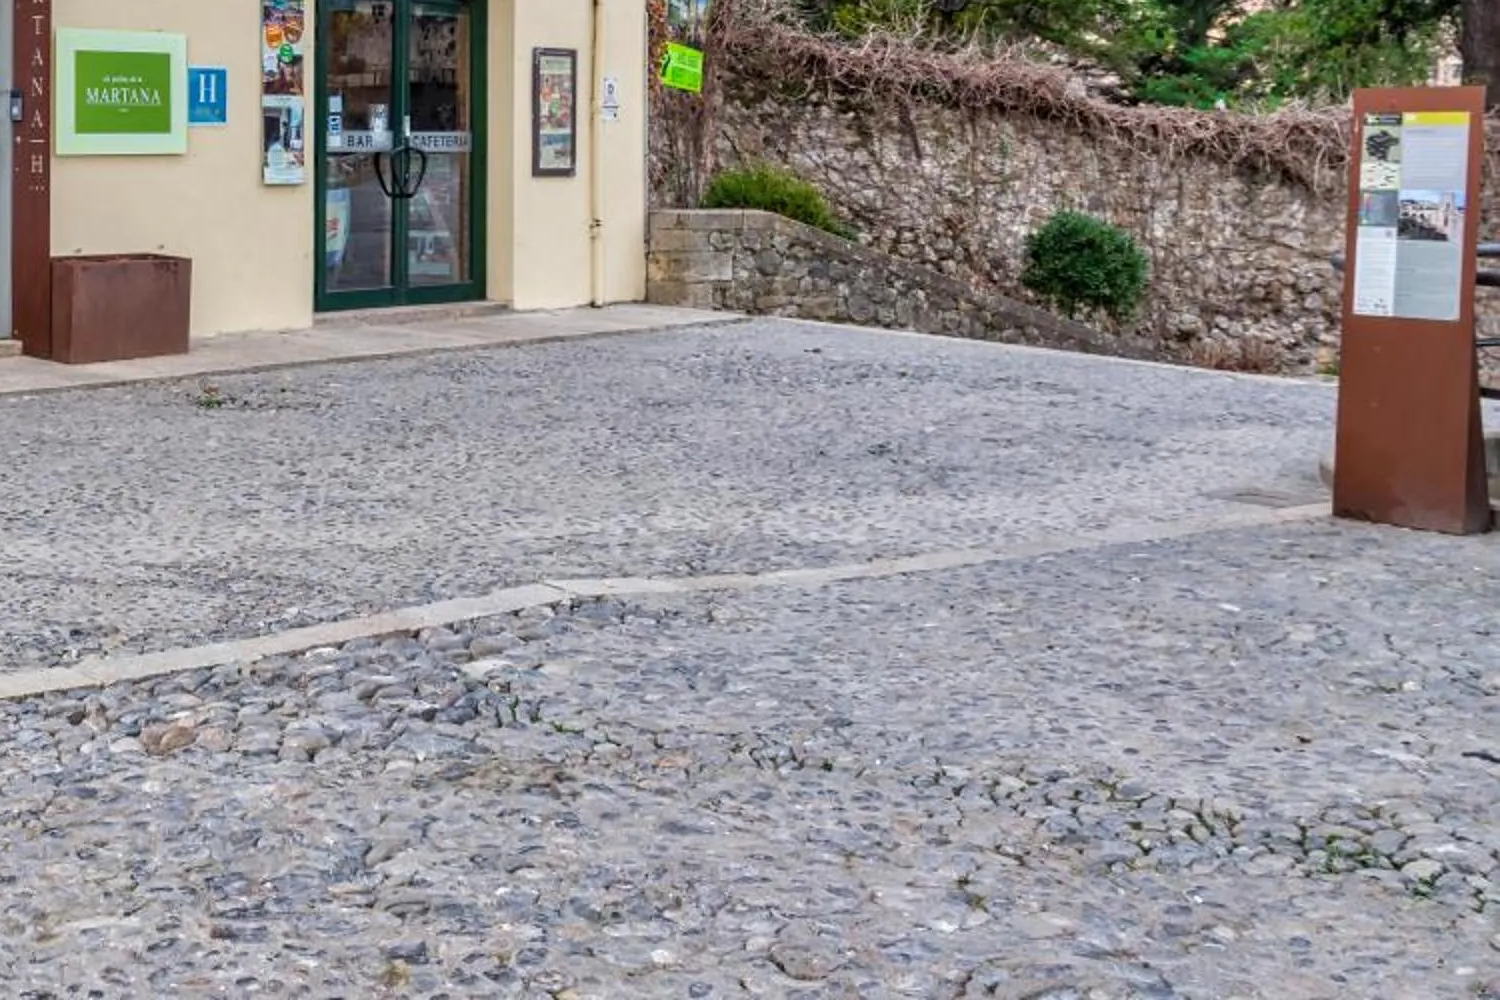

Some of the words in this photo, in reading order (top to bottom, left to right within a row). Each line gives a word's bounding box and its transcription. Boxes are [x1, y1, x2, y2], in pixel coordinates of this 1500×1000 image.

[85, 87, 163, 105] MARTANA
[198, 73, 218, 104] H
[347, 135, 373, 148] BAR
